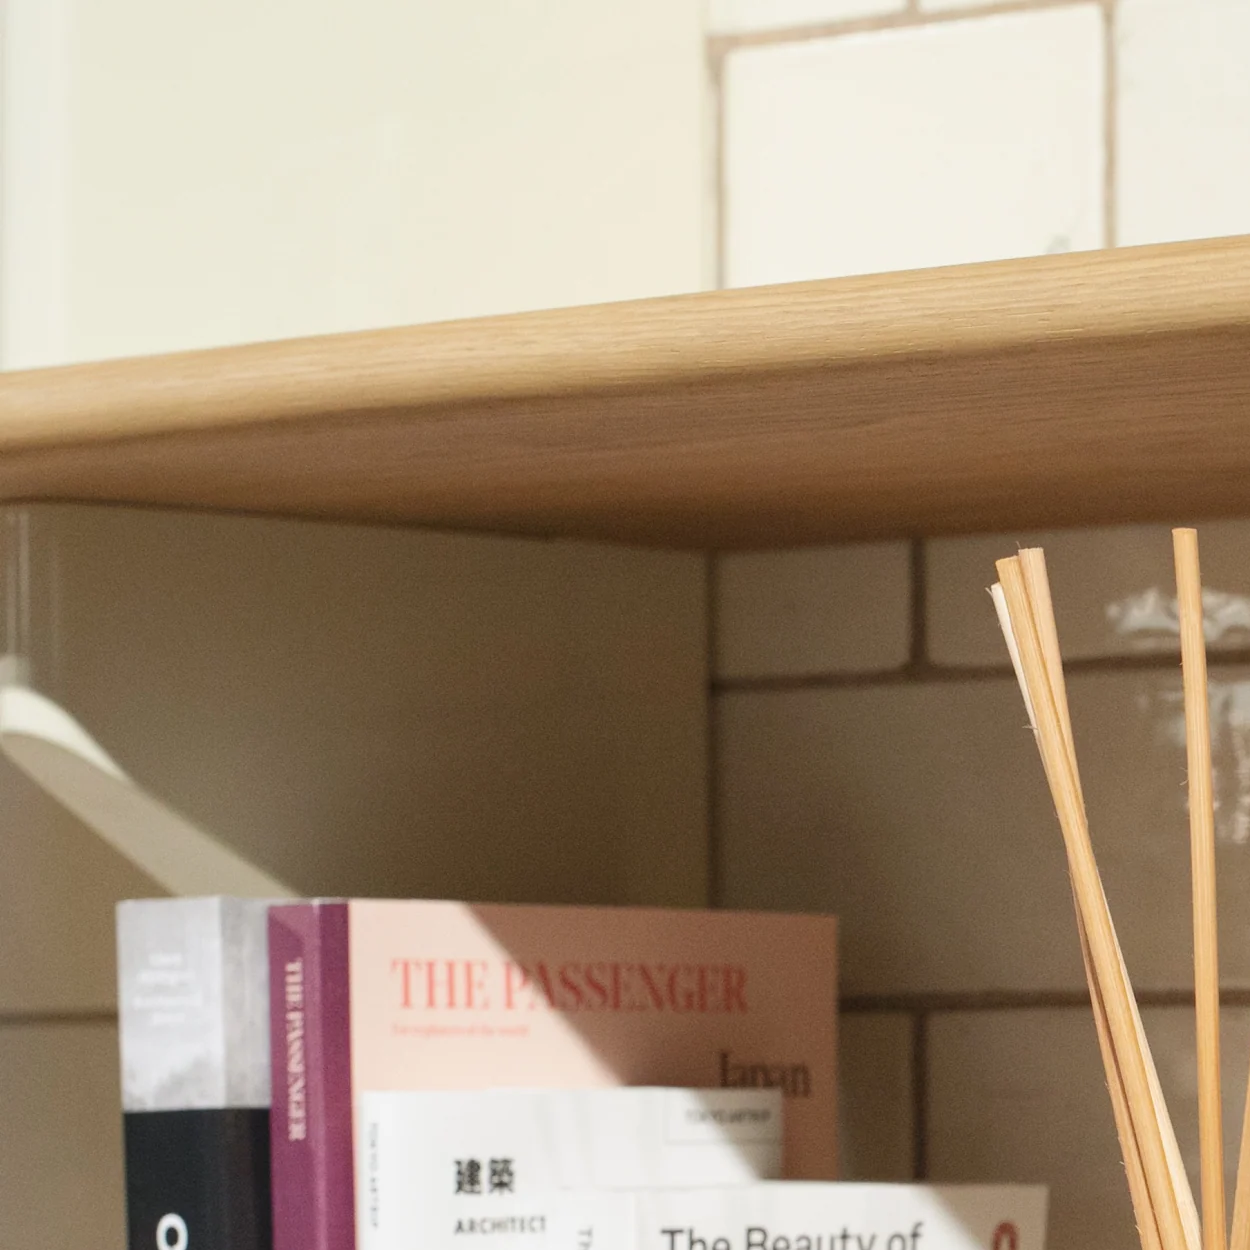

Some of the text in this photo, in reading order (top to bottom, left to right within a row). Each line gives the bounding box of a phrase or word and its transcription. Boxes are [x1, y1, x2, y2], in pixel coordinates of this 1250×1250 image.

[390, 958, 748, 1014] THE PASSENGER
[454, 1157, 515, 1195] 建築
